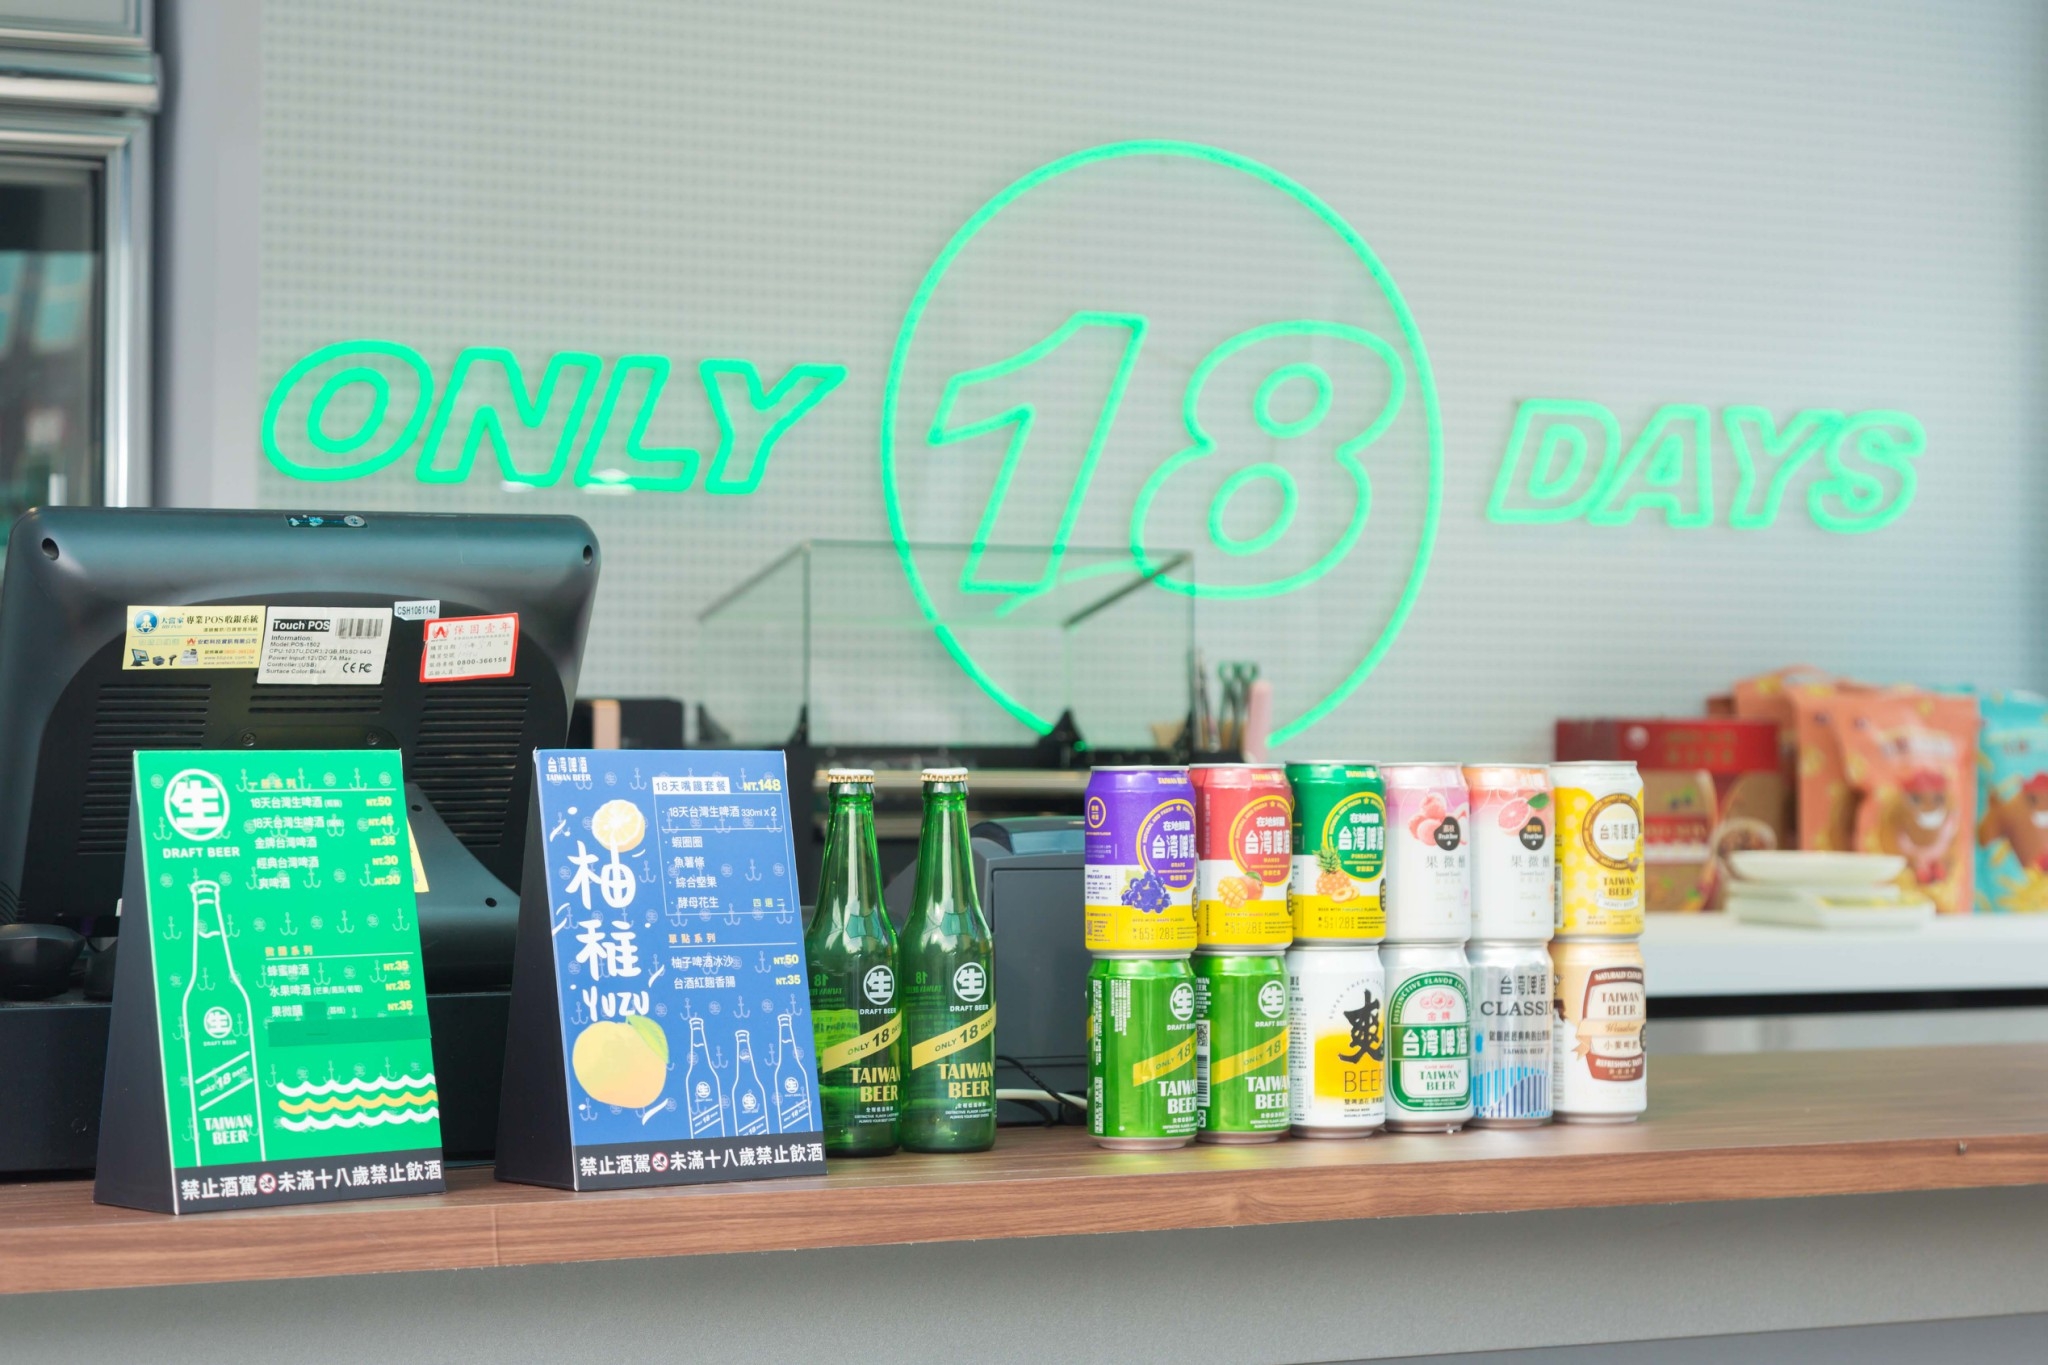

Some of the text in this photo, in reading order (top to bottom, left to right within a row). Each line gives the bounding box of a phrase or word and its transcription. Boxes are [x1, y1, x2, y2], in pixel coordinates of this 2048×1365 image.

[262, 310, 1925, 600] ONLY 18 DAYS
[397, 605, 437, 616] CSH1061140
[186, 614, 259, 625] 專業POS收銀系統
[273, 620, 331, 631] Touch POS
[454, 622, 512, 635] 保固壹年
[456, 656, 507, 666] 0800-366158
[343, 662, 357, 674] CE
[656, 780, 726, 792] 18天嘴饞套餐
[743, 779, 781, 792] NT.148
[170, 780, 223, 828] 生
[250, 796, 323, 809] 18天台灣生啤酒
[365, 796, 393, 807] NT.50
[668, 806, 777, 818] 18天台灣生啤酒 330ml 2
[253, 816, 325, 829] 18天台灣生啤酒
[367, 815, 394, 827] NT.45
[254, 836, 317, 849] 金牌台灣啤酒
[369, 835, 396, 847] NT.35
[162, 846, 241, 859] DRAFT BEER
[256, 856, 319, 869] 經典台灣啤酒
[372, 855, 399, 866] NT.30
[673, 856, 705, 868] 魚薯條
[258, 876, 291, 889] 爽啤酒
[374, 874, 401, 886] NT.30
[675, 876, 718, 889] 綜合堅果
[1603, 876, 1635, 887] TAIWAN
[1608, 887, 1633, 897] BEER
[677, 896, 719, 909] 酵母花生
[668, 932, 717, 945] 單點系列
[671, 955, 734, 970] 柚子啤酒冰沙
[773, 953, 799, 965] NT.50
[267, 963, 310, 977] 蜂蜜啤酒
[383, 960, 410, 972] NT.35
[385, 980, 411, 991] NT.35
[775, 974, 801, 986] NT.35
[867, 971, 892, 998] 生
[957, 968, 984, 995] 生
[269, 983, 312, 997] 水果啤酒
[1173, 989, 1192, 1015] 生
[1262, 986, 1283, 1011] 生
[1393, 976, 1453, 1023] DISTINCTIVE FLAVOR
[1602, 991, 1640, 1003] TAIWAN
[387, 1000, 413, 1011] NT.35
[582, 985, 650, 1023] YUZU
[1608, 1004, 1636, 1016] BEER
[206, 1011, 228, 1034] 生
[1166, 1023, 1185, 1031] DRAFT
[1254, 1020, 1275, 1028] DRAFT
[1338, 988, 1385, 1064] 爽
[848, 1027, 890, 1056] ONLY 18
[934, 1037, 957, 1052] ONLY
[960, 1024, 979, 1044] 18
[1155, 1043, 1192, 1071] ONLY 18
[1243, 1040, 1281, 1066] ONLY 18
[1595, 1058, 1630, 1068] REFRESHING
[849, 1066, 901, 1083] TAIWAN
[937, 1061, 994, 1080] TAIWAN
[1419, 1070, 1460, 1080] TAIWAN
[216, 1072, 232, 1089] 18
[1426, 1081, 1456, 1091] BEER
[860, 1085, 898, 1103] BEER
[948, 1080, 990, 1099] BEER
[1157, 1080, 1197, 1097] TAIWA
[203, 1114, 253, 1131] TAIWAN
[212, 1129, 249, 1145] BEER
[580, 1142, 824, 1177] 禁止酒駕 未滿十八歲禁止飲酒
[181, 1159, 442, 1201] 禁止酒駕 未滿十八歲禁止飲酒
